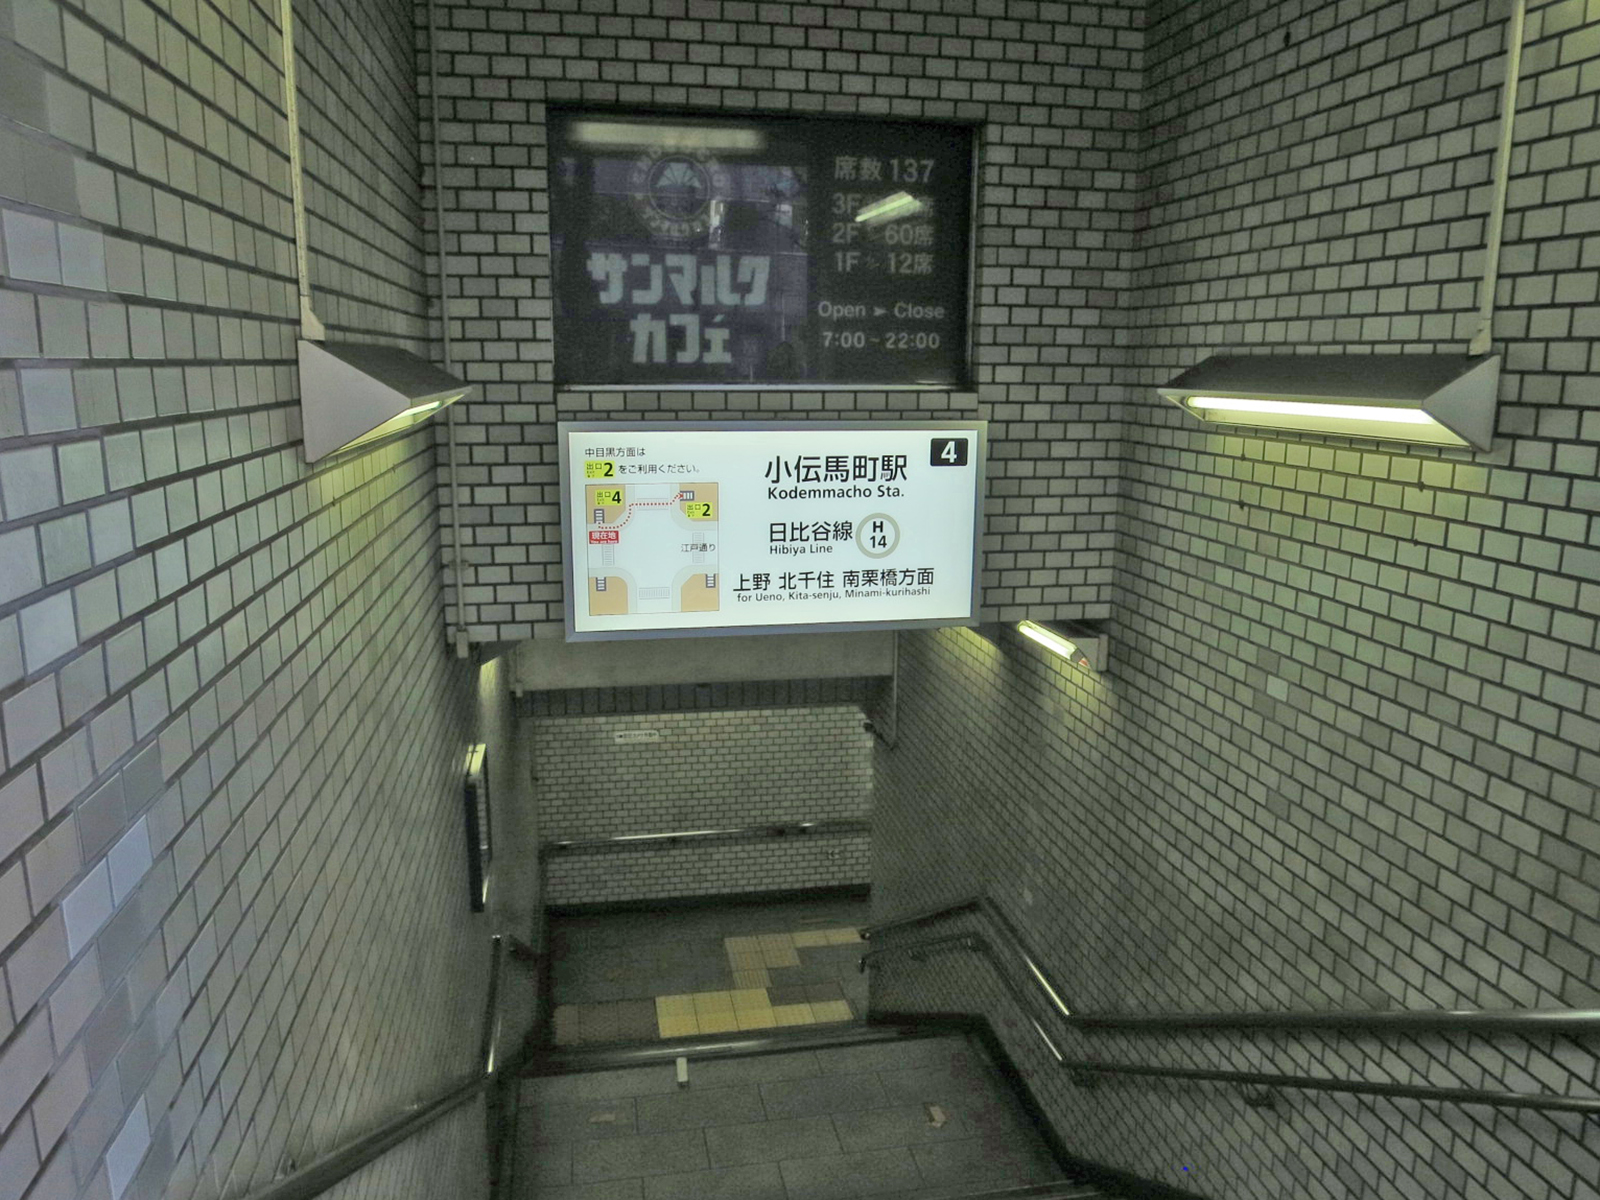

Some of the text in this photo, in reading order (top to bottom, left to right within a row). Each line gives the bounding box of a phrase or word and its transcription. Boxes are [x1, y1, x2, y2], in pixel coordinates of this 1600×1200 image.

[889, 159, 935, 183] 137
[832, 223, 861, 244] 2F
[836, 251, 861, 271] 1F
[587, 253, 770, 305] サンマルク
[818, 300, 945, 321] Open Close
[630, 313, 732, 363] カフェ
[585, 447, 646, 458] 中目黒方面は
[939, 440, 958, 463] 4
[603, 462, 614, 477] 2
[618, 463, 699, 475] をご利用ください。
[765, 455, 908, 484] 小伝馬町駅
[611, 490, 622, 504] 4
[768, 484, 905, 500] Kodemmacho Sta.
[702, 503, 711, 517] 2
[769, 520, 853, 543] 日比谷線
[872, 520, 884, 533] H
[681, 543, 716, 553] 江戸通り
[769, 542, 833, 556] Hibiya Line
[869, 535, 887, 549] 14
[732, 567, 935, 592] 上野 北千住 南栗橋方面
[736, 586, 931, 603] for Ueno, Kita-senju, Minami-kurihashi
